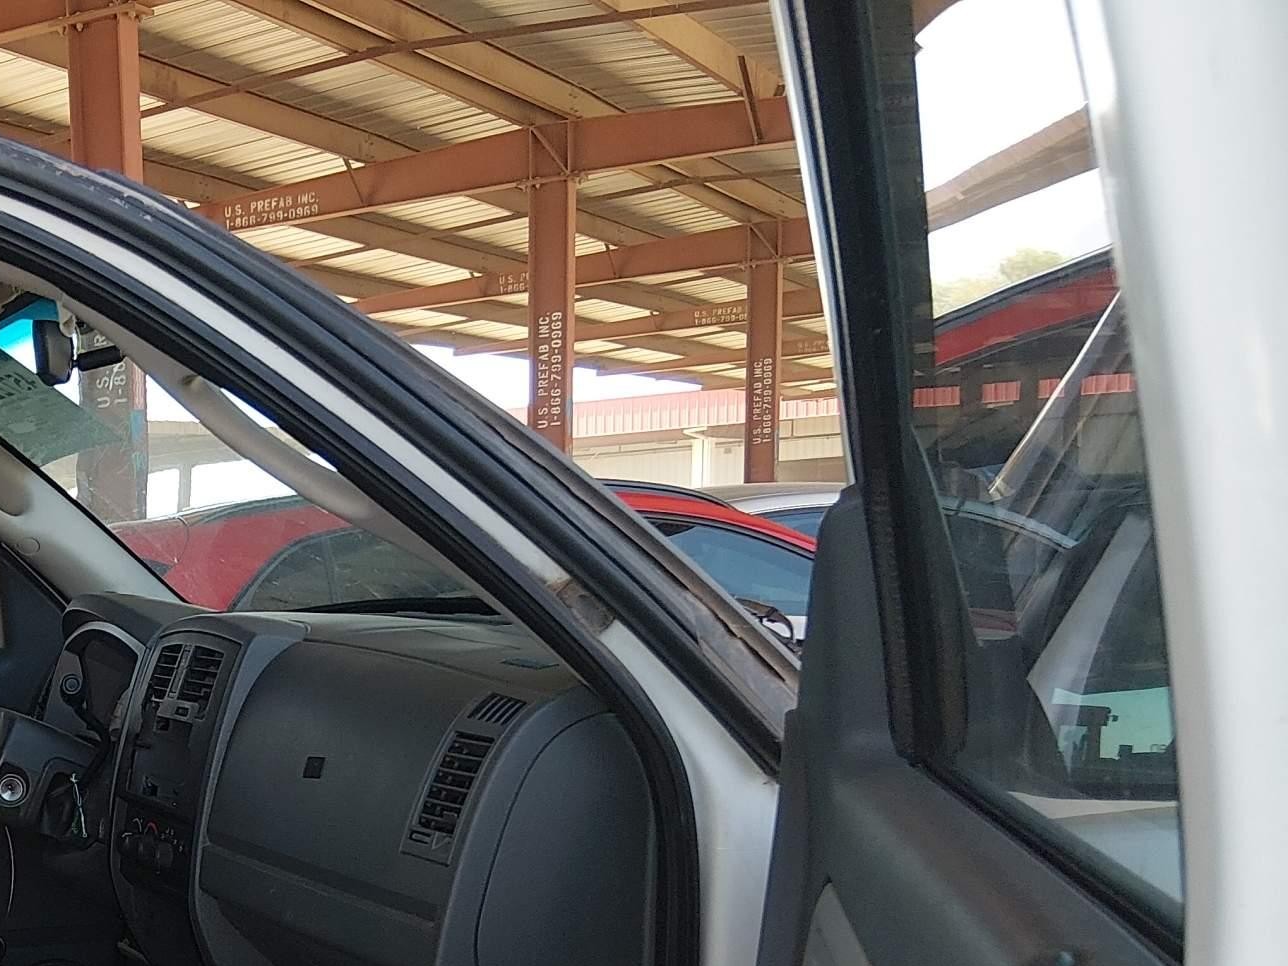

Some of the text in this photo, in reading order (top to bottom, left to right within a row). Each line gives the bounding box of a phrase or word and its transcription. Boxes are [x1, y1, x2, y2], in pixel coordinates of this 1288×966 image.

[224, 191, 319, 218] U.S. PREFAB INC.
[537, 312, 550, 429] U.S. PREFAB INC.
[550, 311, 562, 426] 1-866-799-0969
[753, 382, 763, 421] PREFAB
[762, 358, 773, 442] 1-866-799-0969
